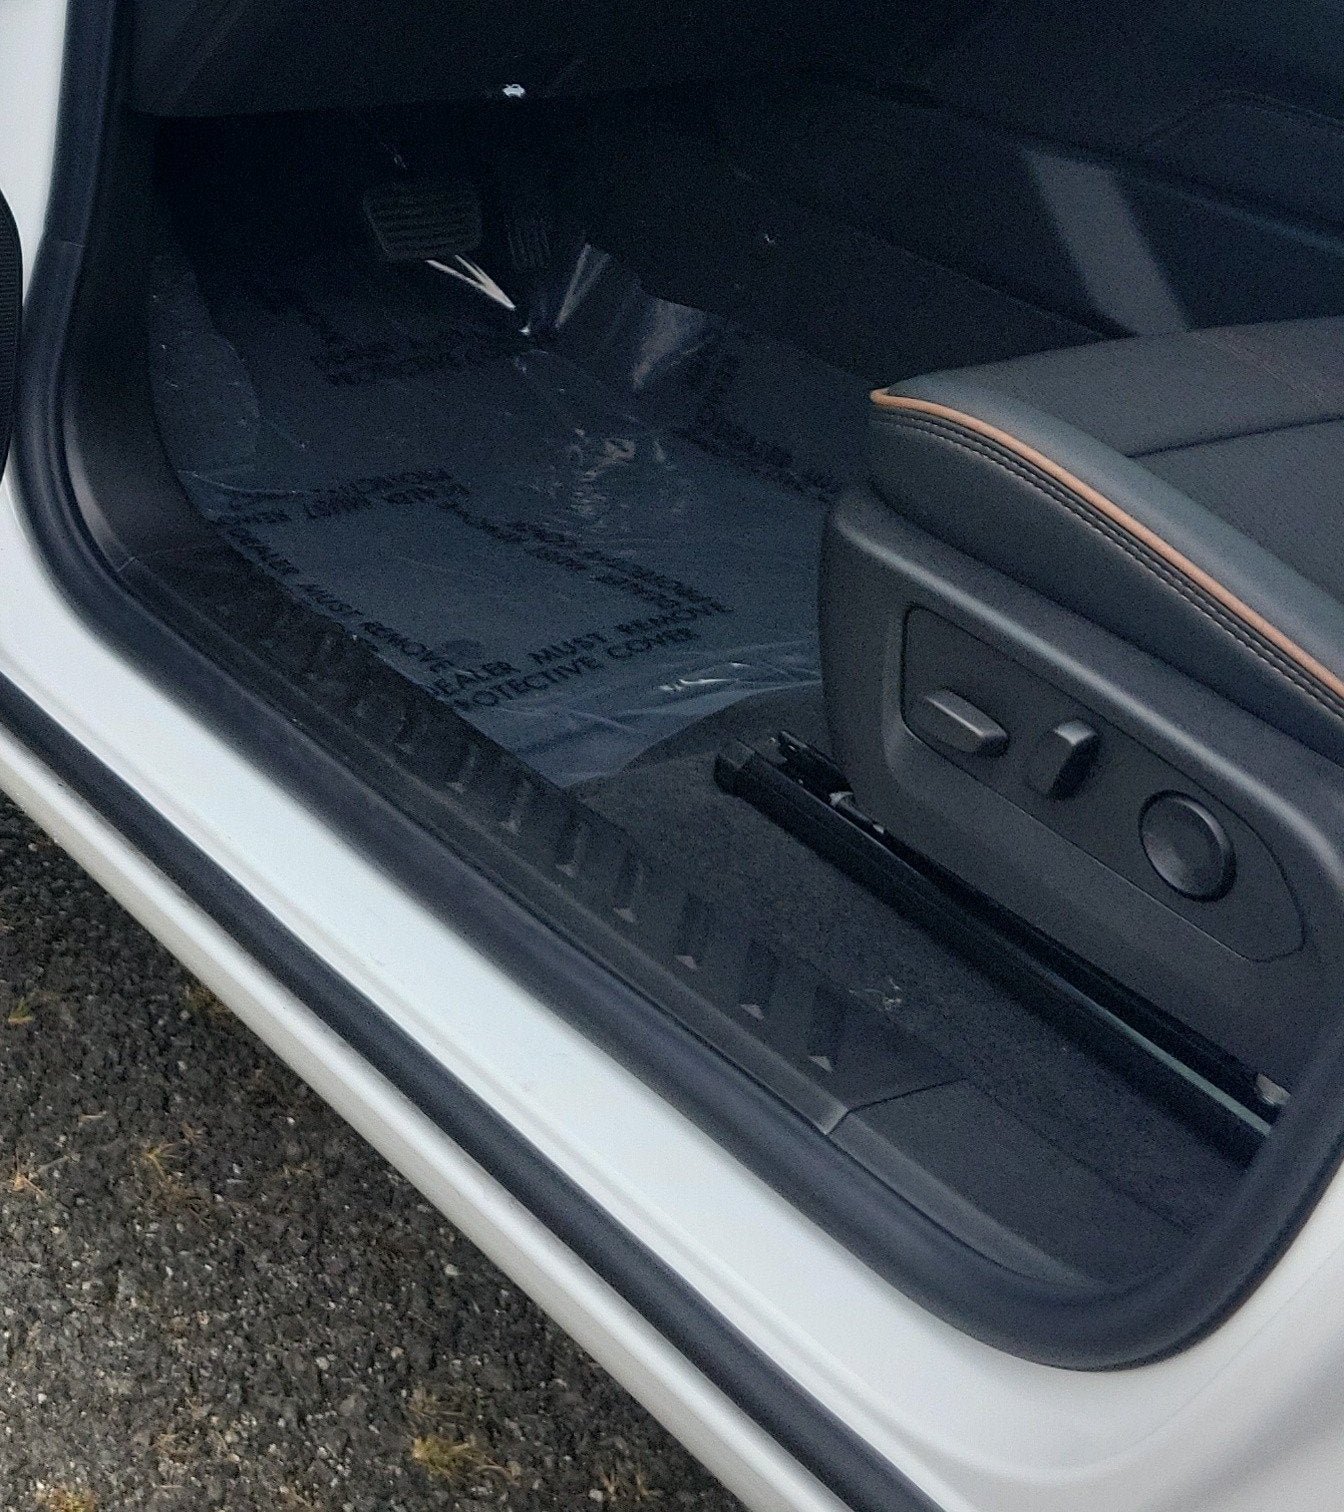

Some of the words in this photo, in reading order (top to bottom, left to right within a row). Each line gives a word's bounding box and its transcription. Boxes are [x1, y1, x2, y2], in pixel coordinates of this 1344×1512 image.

[528, 631, 609, 667] MUST
[614, 600, 734, 635] REMOVE
[605, 626, 701, 660] COVER
